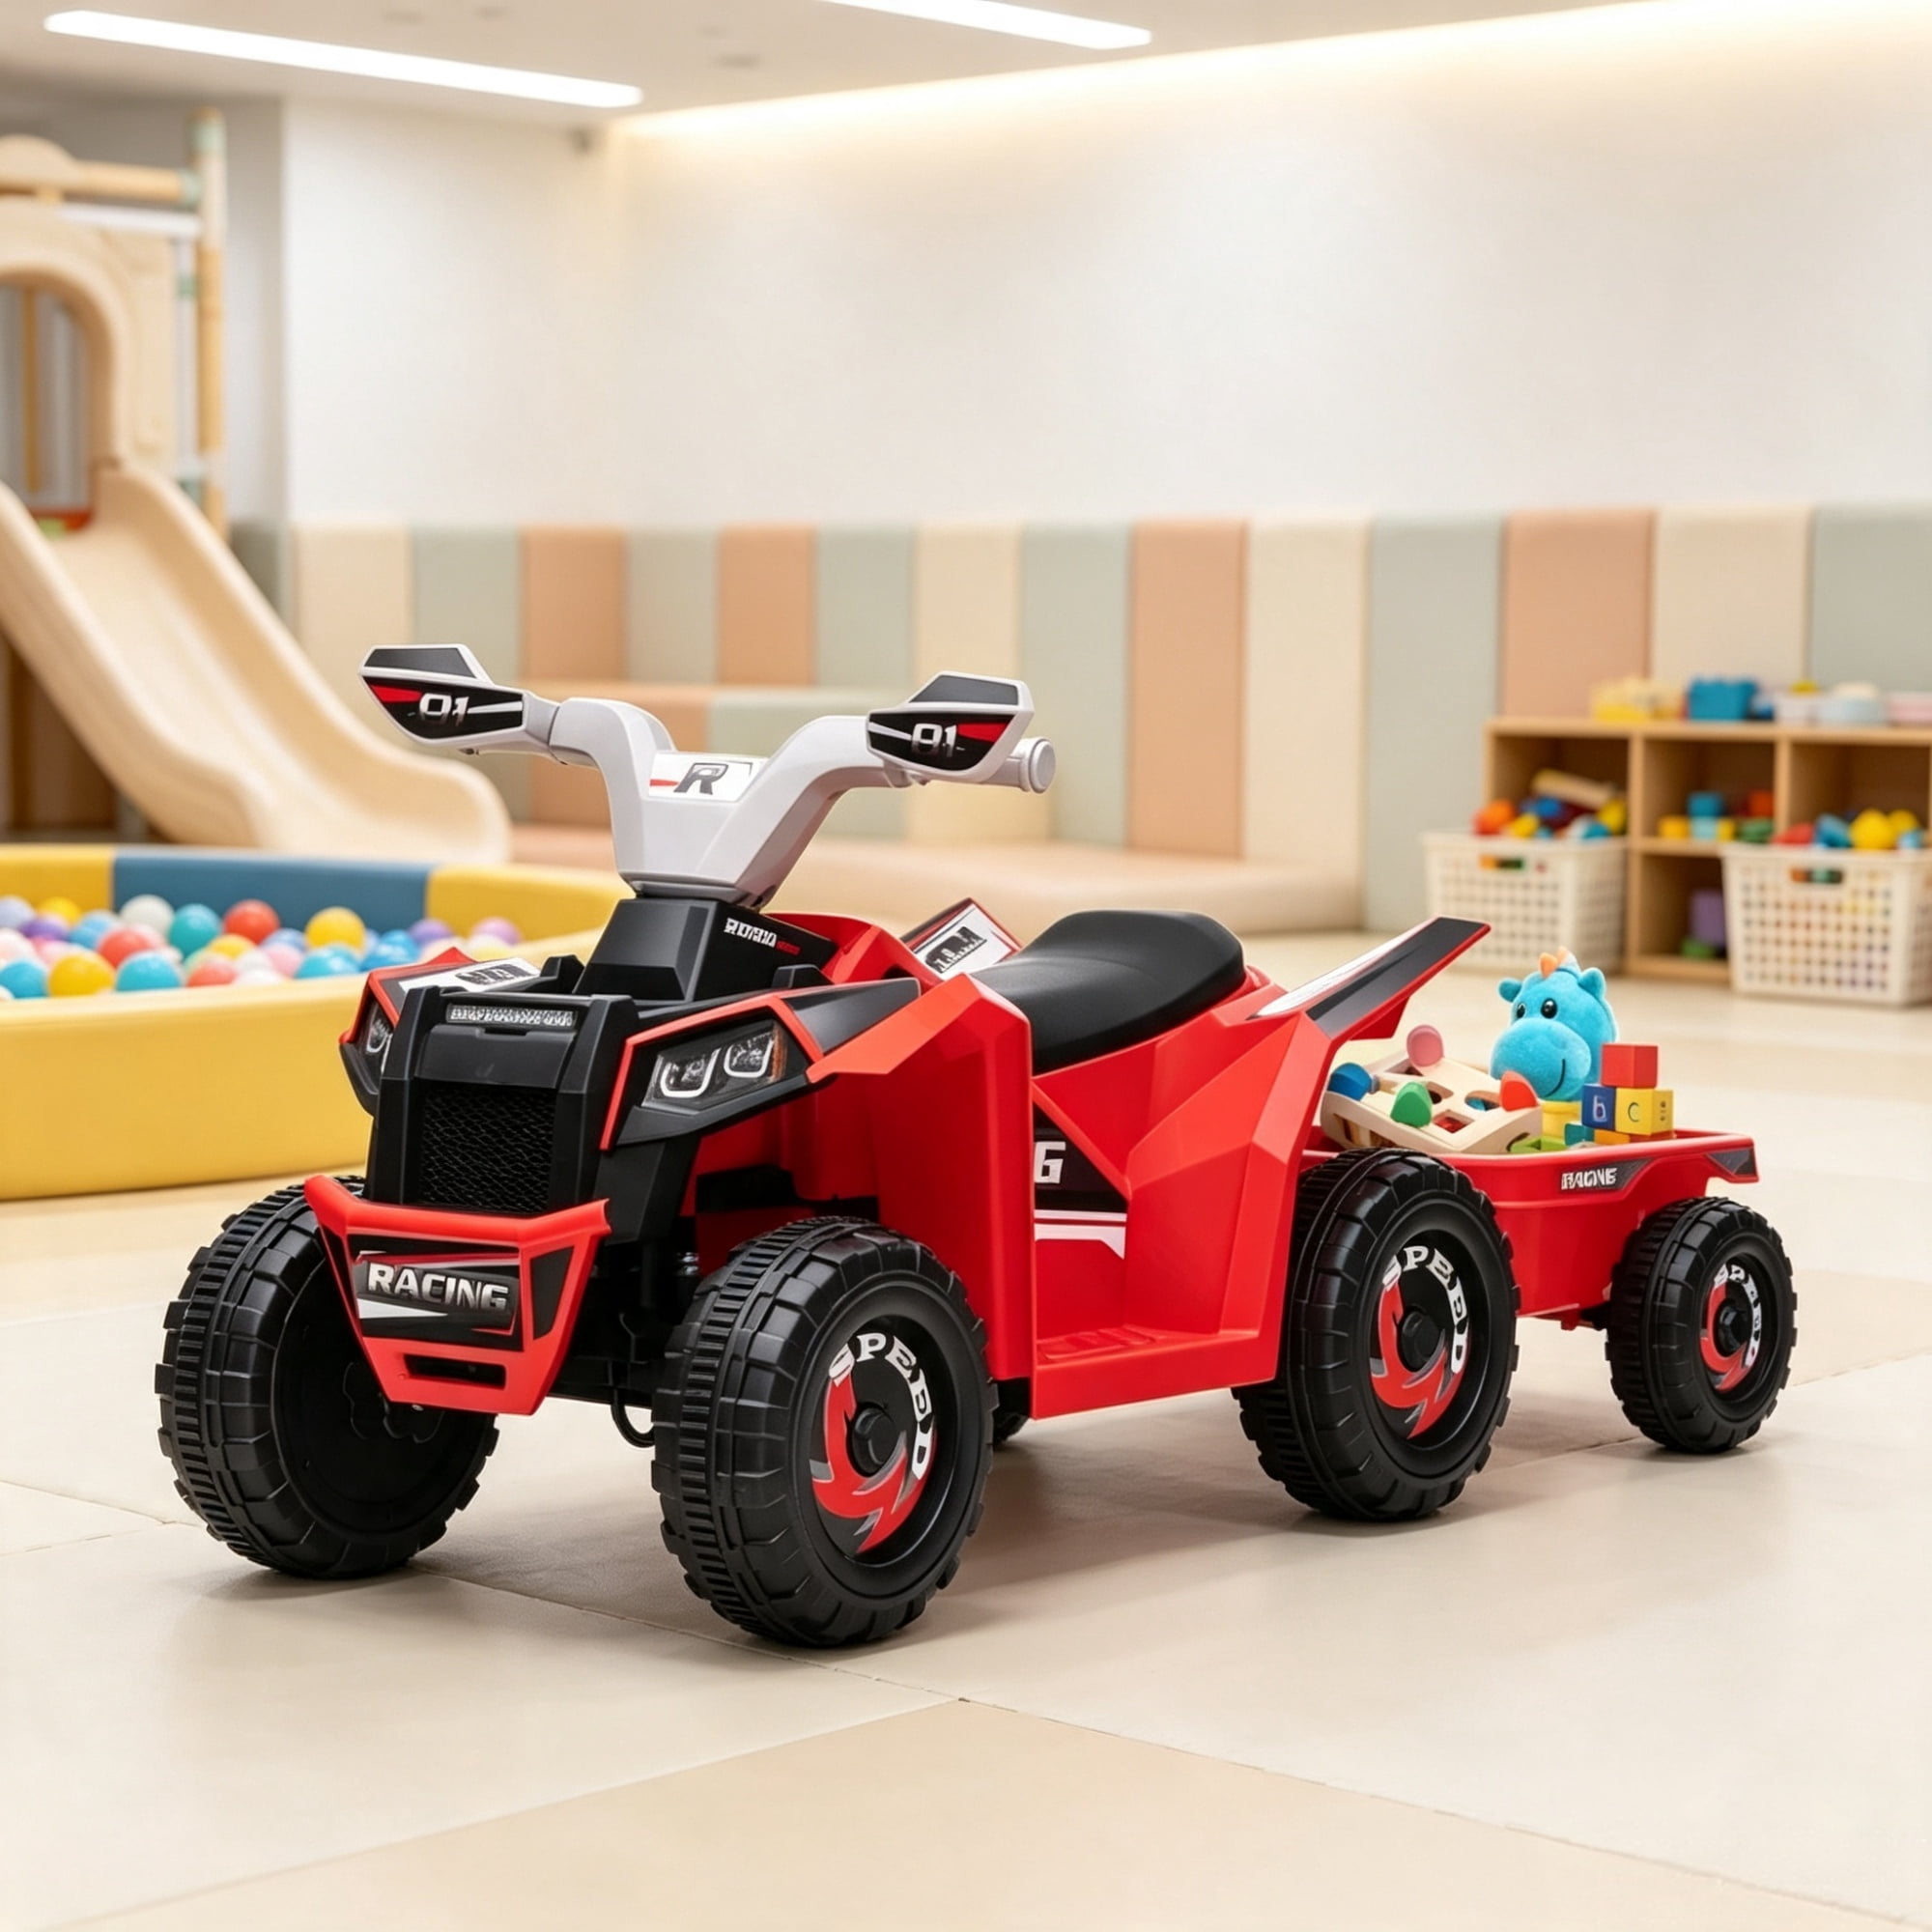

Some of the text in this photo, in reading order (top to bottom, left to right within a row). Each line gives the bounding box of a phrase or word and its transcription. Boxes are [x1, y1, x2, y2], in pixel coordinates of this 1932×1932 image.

[419, 692, 470, 724] 01
[911, 723, 958, 756] 01
[672, 762, 729, 795] R
[367, 1262, 509, 1311] RACING
